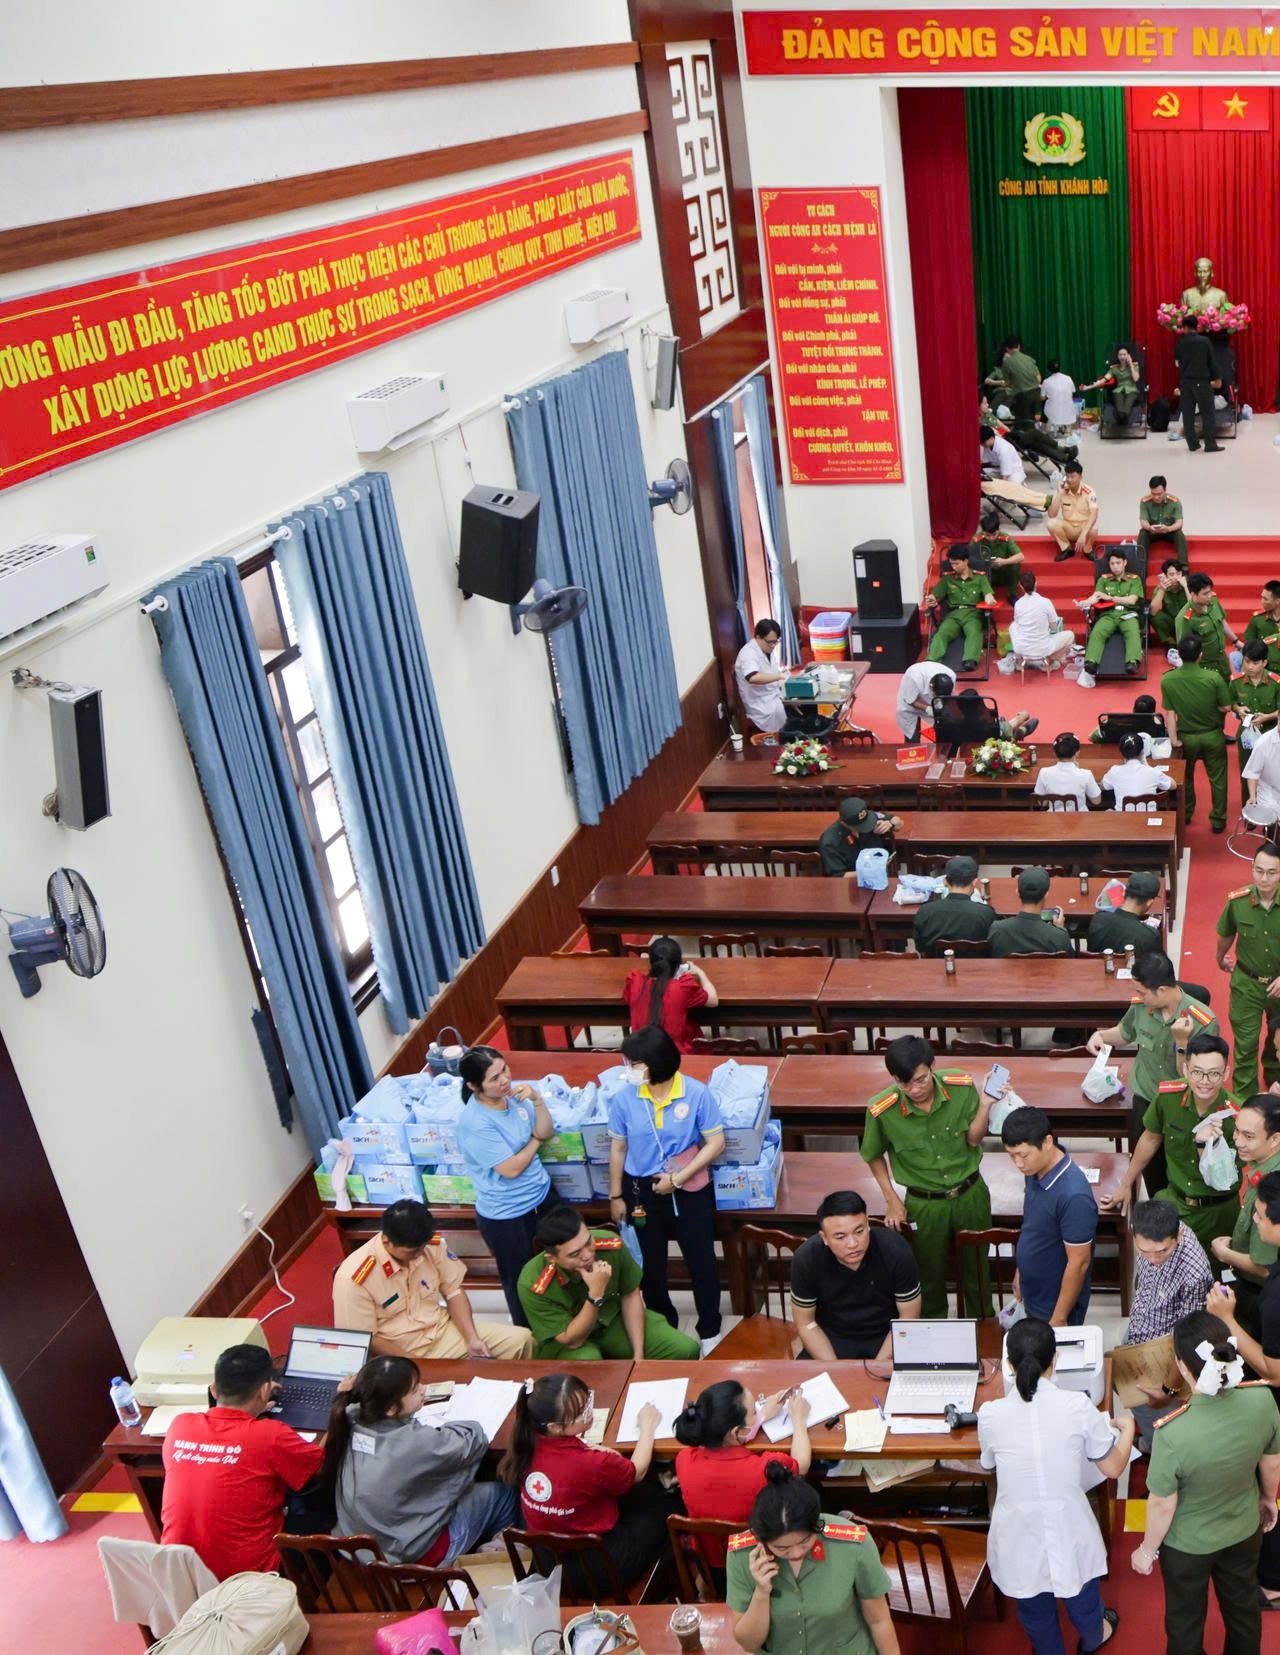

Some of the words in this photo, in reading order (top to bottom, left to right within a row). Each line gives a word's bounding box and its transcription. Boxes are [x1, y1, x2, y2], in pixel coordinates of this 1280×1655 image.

[782, 17, 885, 59] ĐẢNG
[897, 19, 997, 65] CỘNG
[1009, 16, 1087, 57] SẢN
[1100, 19, 1178, 64] VIỆT
[1192, 26, 1280, 57] NAM
[42, 384, 91, 435] XÂY
[92, 367, 154, 420] DỰNG
[152, 354, 193, 400] LỰC
[192, 335, 253, 382] LƯỢNG
[252, 321, 298, 363] CAND
[296, 307, 336, 347] THỰC
[335, 298, 357, 336] SỰ
[356, 287, 400, 328] TRONG
[400, 277, 436, 314] SẠCH,
[433, 266, 464, 299] VỮNG
[463, 254, 498, 288] MẠNH,
[52, 315, 107, 372] MẪU
[107, 317, 135, 356] ĐI
[133, 297, 184, 348] ĐẦU,
[181, 290, 233, 334] TĂNG
[231, 272, 267, 319] TỐC
[266, 268, 298, 309] BỨT
[298, 258, 331, 299] PHÁ
[329, 252, 366, 291] THỰC
[366, 242, 398, 280] HIỆN
[398, 234, 423, 269] CÁC
[423, 223, 446, 261] CHỦ
[446, 218, 486, 251] TRƯƠNG
[486, 206, 507, 240] CỦA
